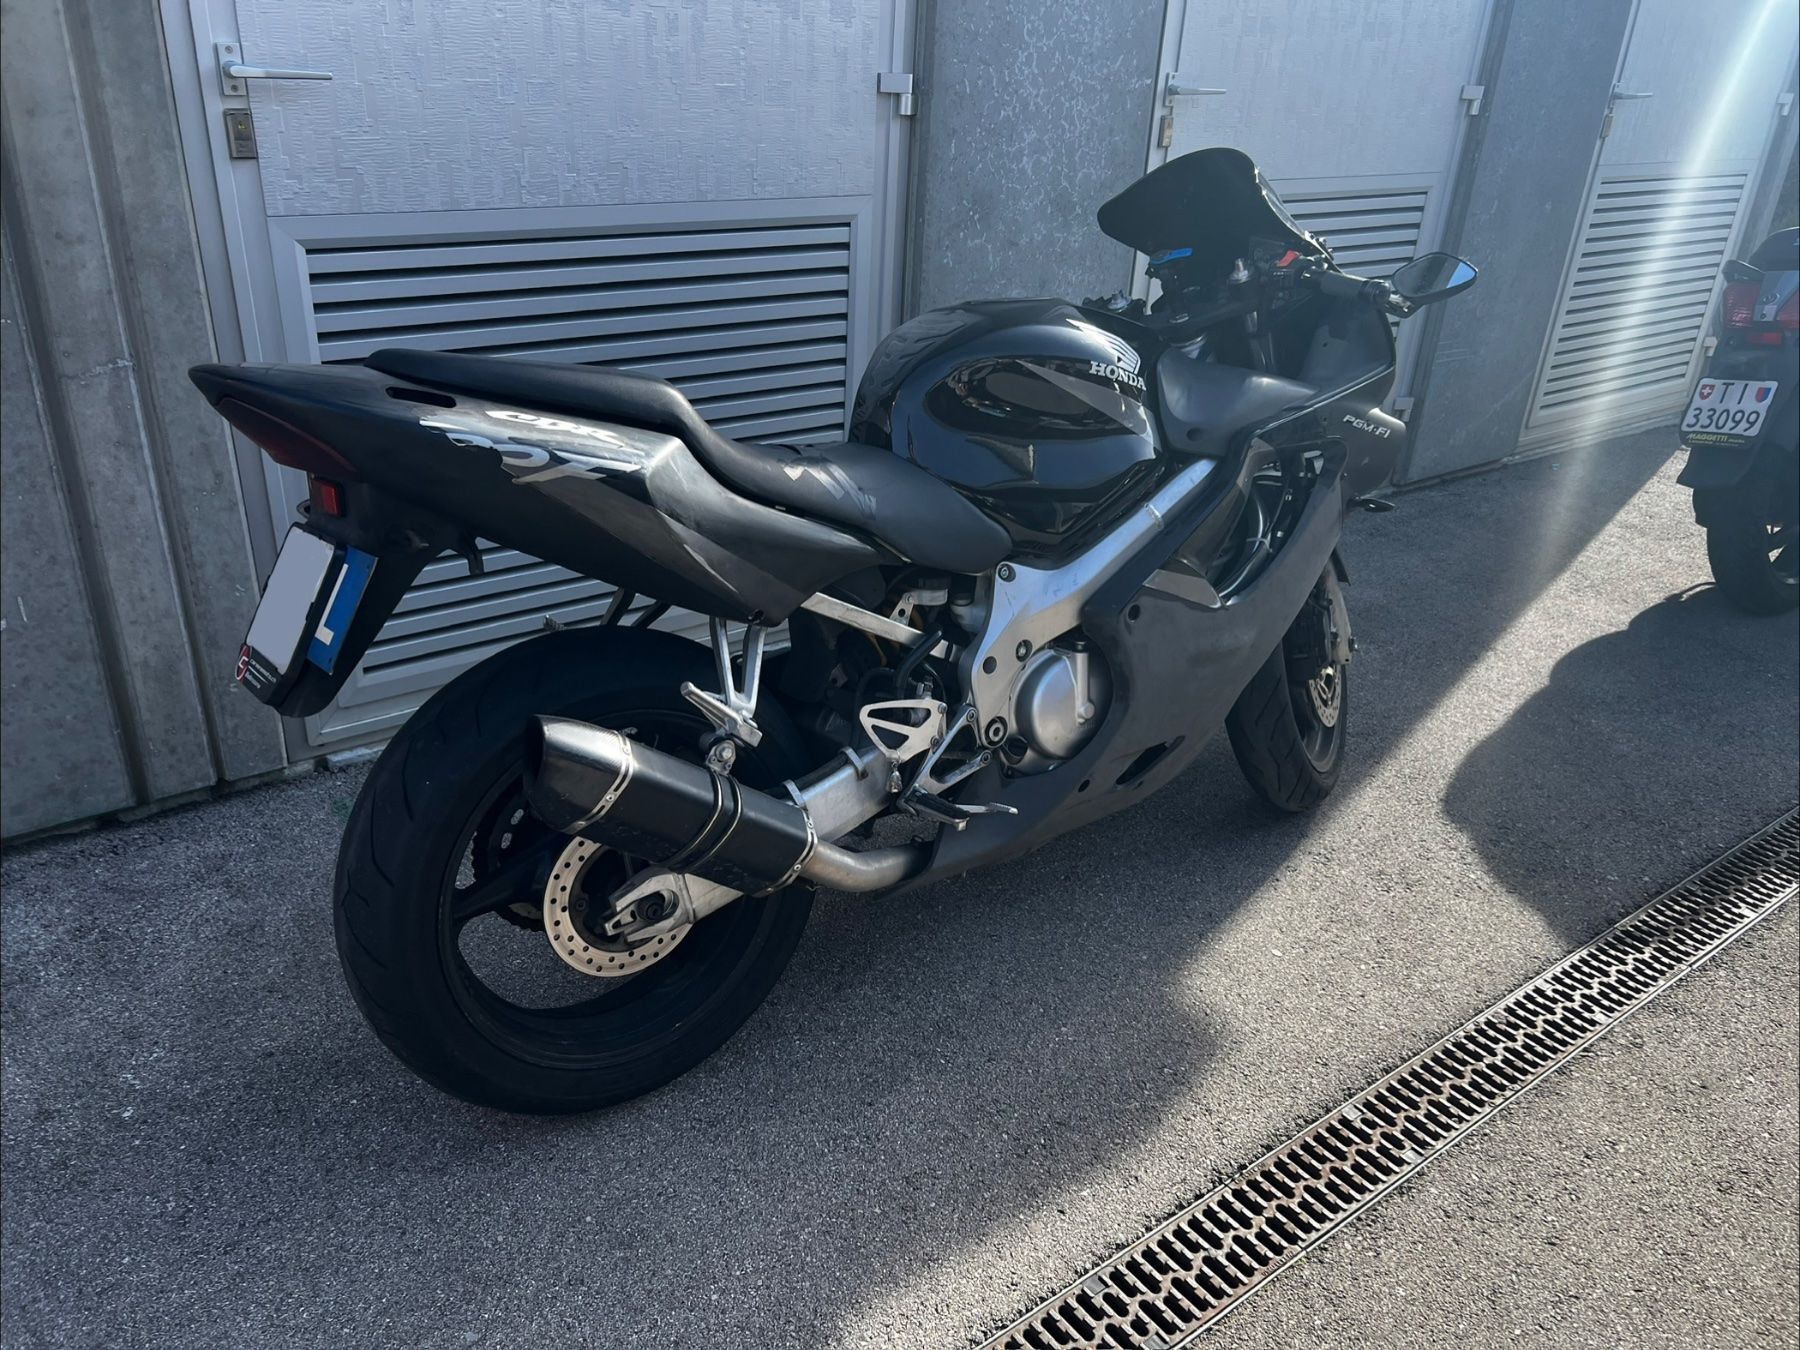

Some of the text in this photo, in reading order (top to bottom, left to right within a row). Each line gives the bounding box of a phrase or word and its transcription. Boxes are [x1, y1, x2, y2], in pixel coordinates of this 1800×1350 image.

[1089, 360, 1147, 391] HONDA
[1719, 382, 1749, 404] TI
[1685, 407, 1760, 432] 33099
[315, 563, 349, 645] L
